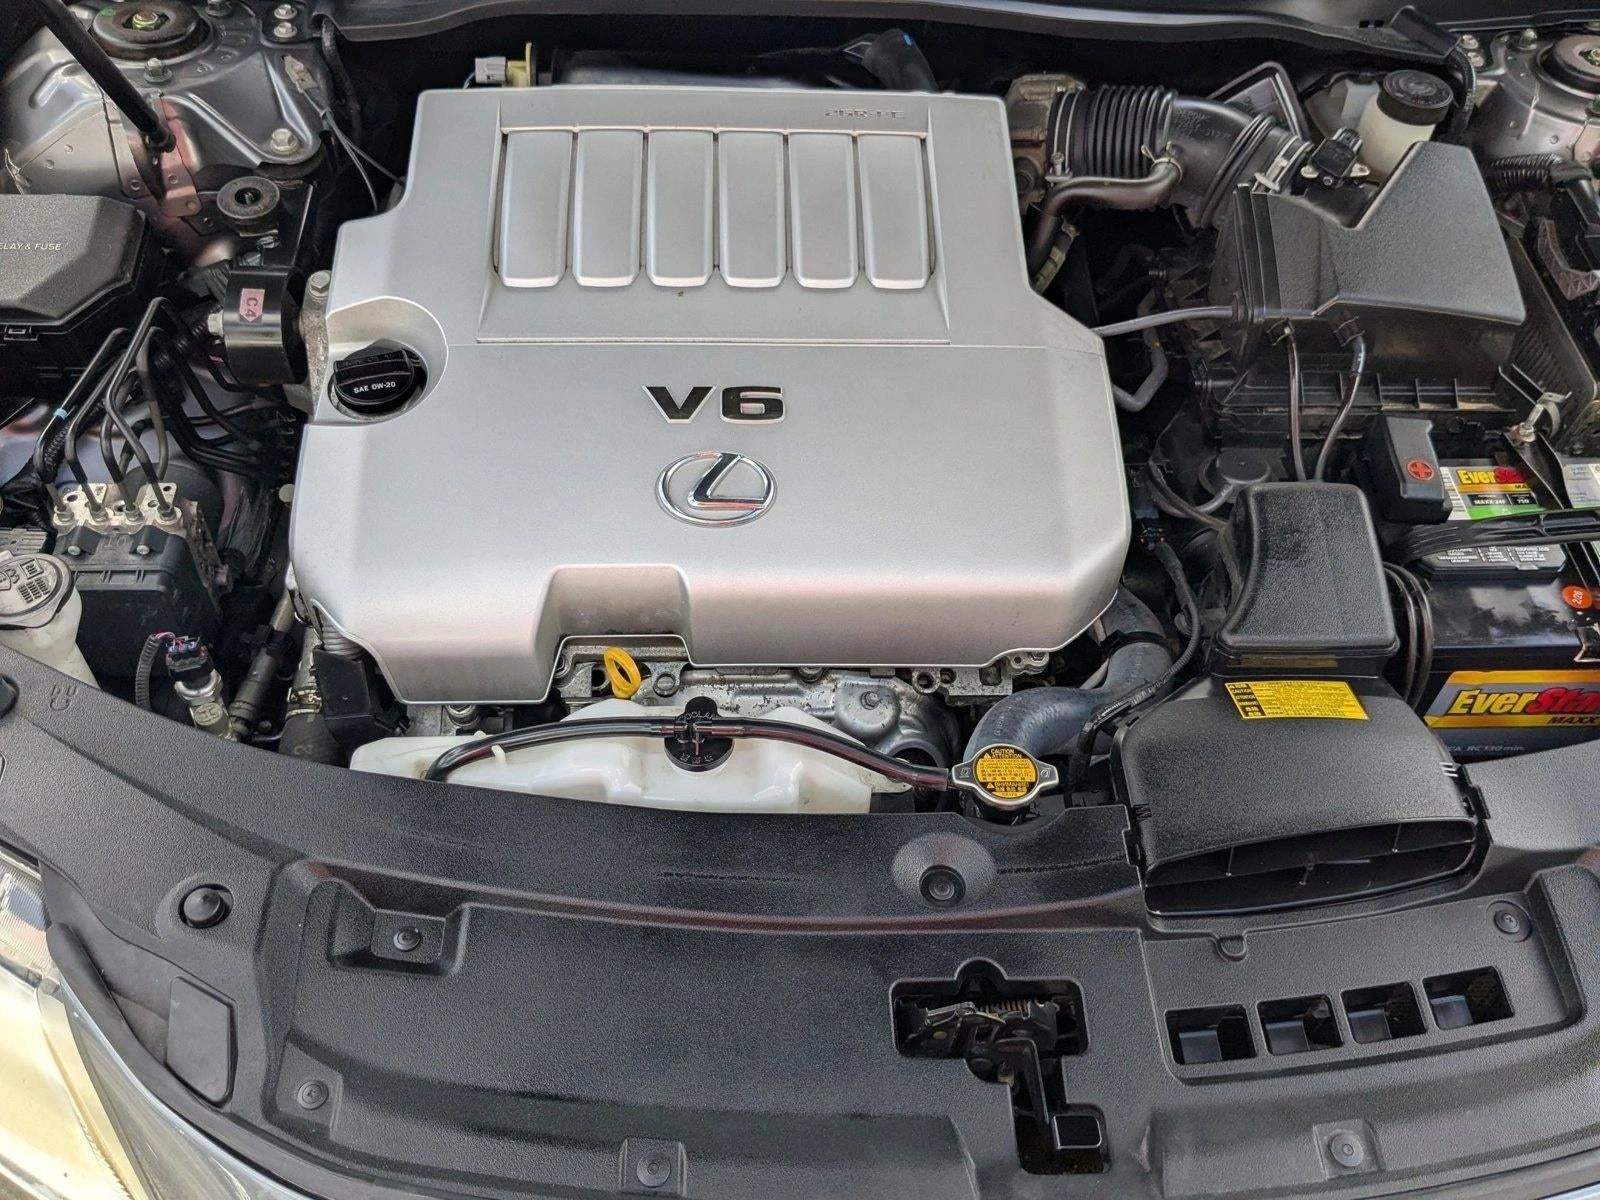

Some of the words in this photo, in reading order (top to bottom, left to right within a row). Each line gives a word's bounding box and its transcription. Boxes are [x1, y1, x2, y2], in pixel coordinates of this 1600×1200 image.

[34, 242, 62, 250] FUSE
[353, 385, 370, 394] SAE
[371, 381, 396, 390] 0W-20
[641, 384, 786, 425] V6
